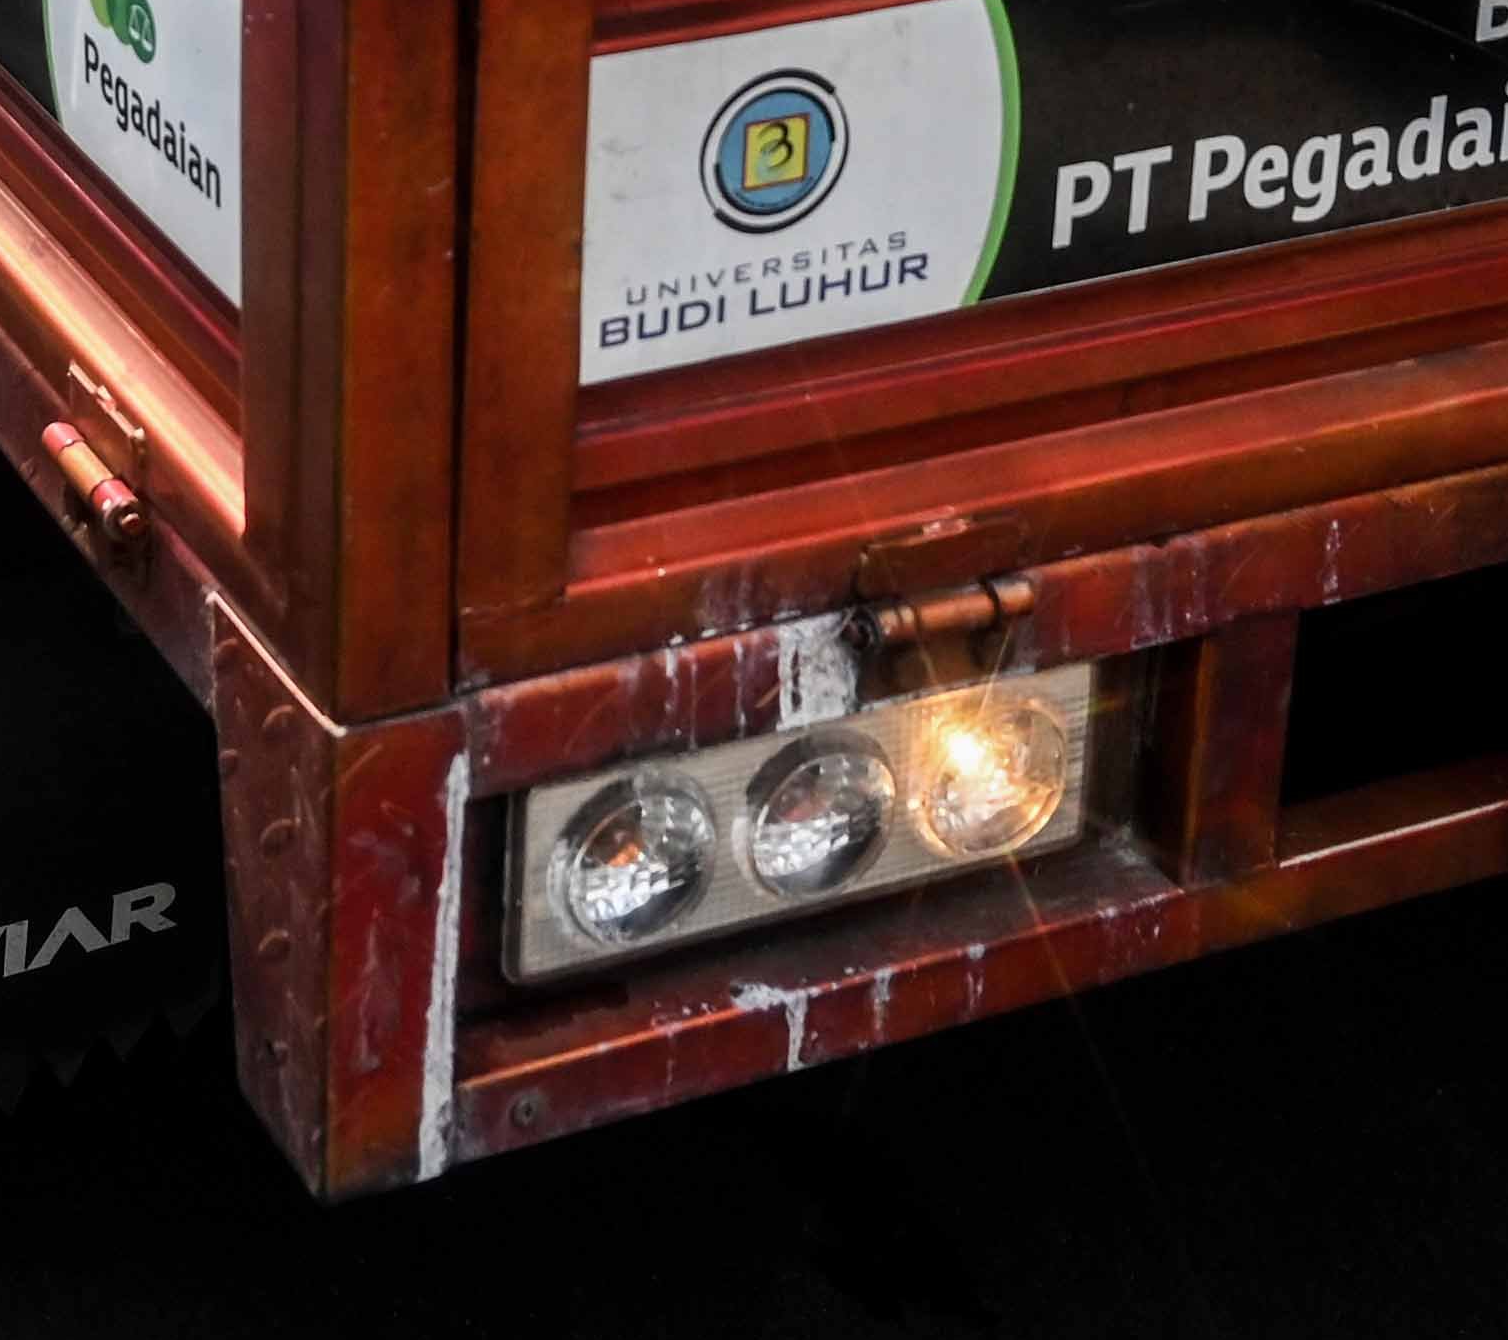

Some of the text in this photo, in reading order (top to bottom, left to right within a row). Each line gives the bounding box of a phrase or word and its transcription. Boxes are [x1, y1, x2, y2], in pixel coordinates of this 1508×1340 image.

[84, 33, 221, 208] Pegadaian
[1052, 146, 1173, 250] PT
[599, 253, 929, 348] BUDI LUHUR
[626, 231, 906, 306] UNIVERSITAS
